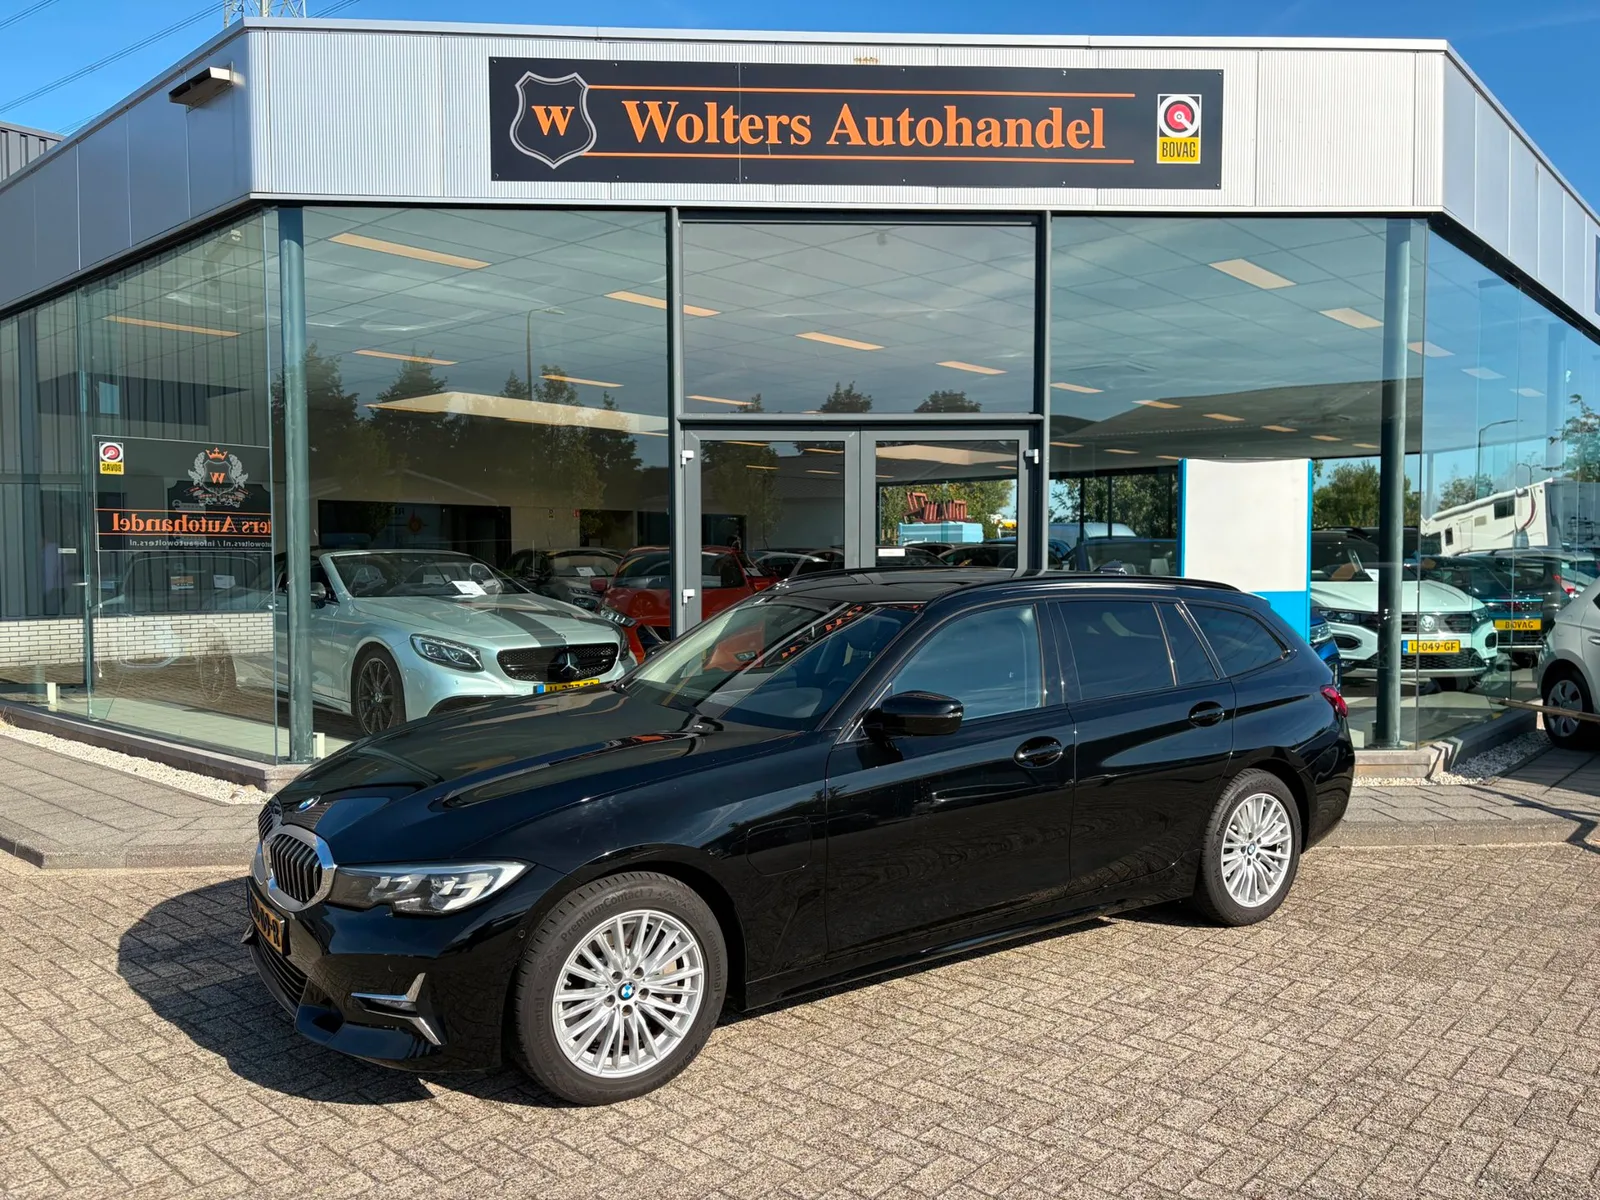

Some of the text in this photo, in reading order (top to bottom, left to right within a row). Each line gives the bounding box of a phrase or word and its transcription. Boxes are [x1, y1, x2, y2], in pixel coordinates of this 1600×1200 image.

[532, 105, 575, 136] W
[621, 100, 1106, 149] Wolters Autohandel
[1161, 141, 1196, 158] BOVAG
[1504, 620, 1534, 629] BOVAG
